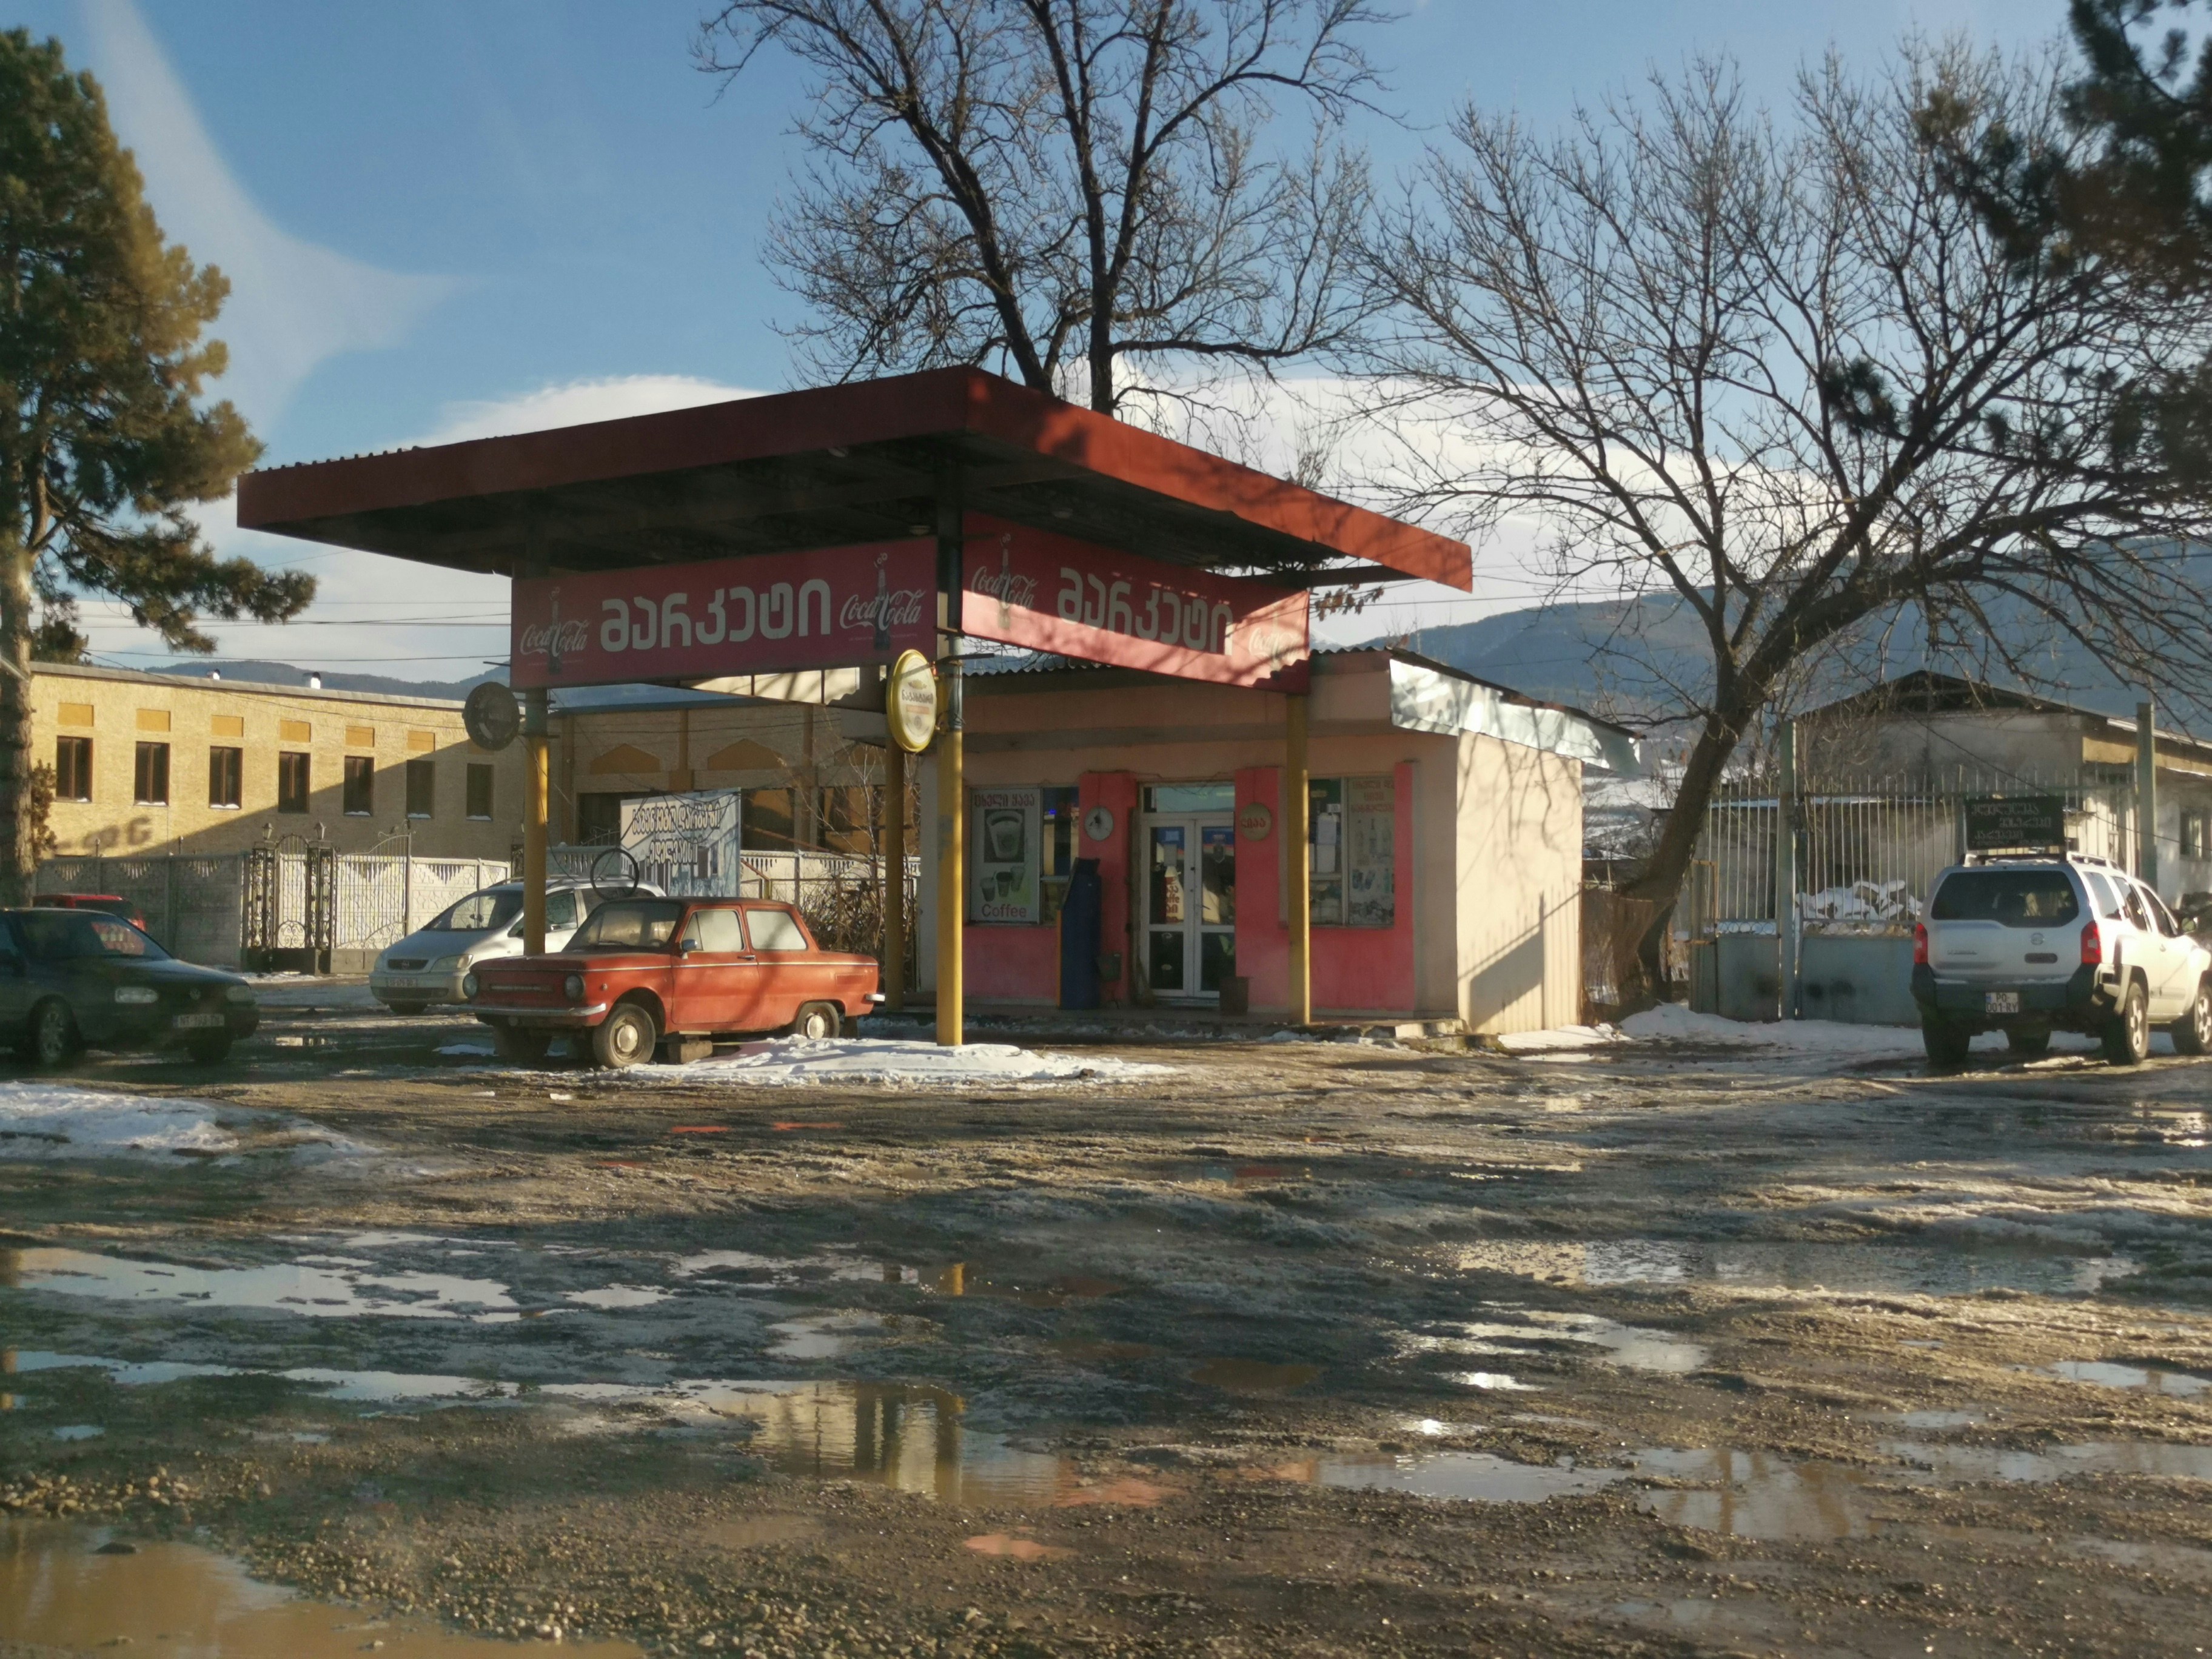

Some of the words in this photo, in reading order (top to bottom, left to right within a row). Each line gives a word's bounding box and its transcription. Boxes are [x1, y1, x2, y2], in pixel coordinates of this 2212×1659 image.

[600, 578, 831, 652] მარკეტი
[1057, 567, 1234, 657] მარკეტი
[974, 794, 1008, 808] ცხელი
[981, 903, 1027, 917] Coffee
